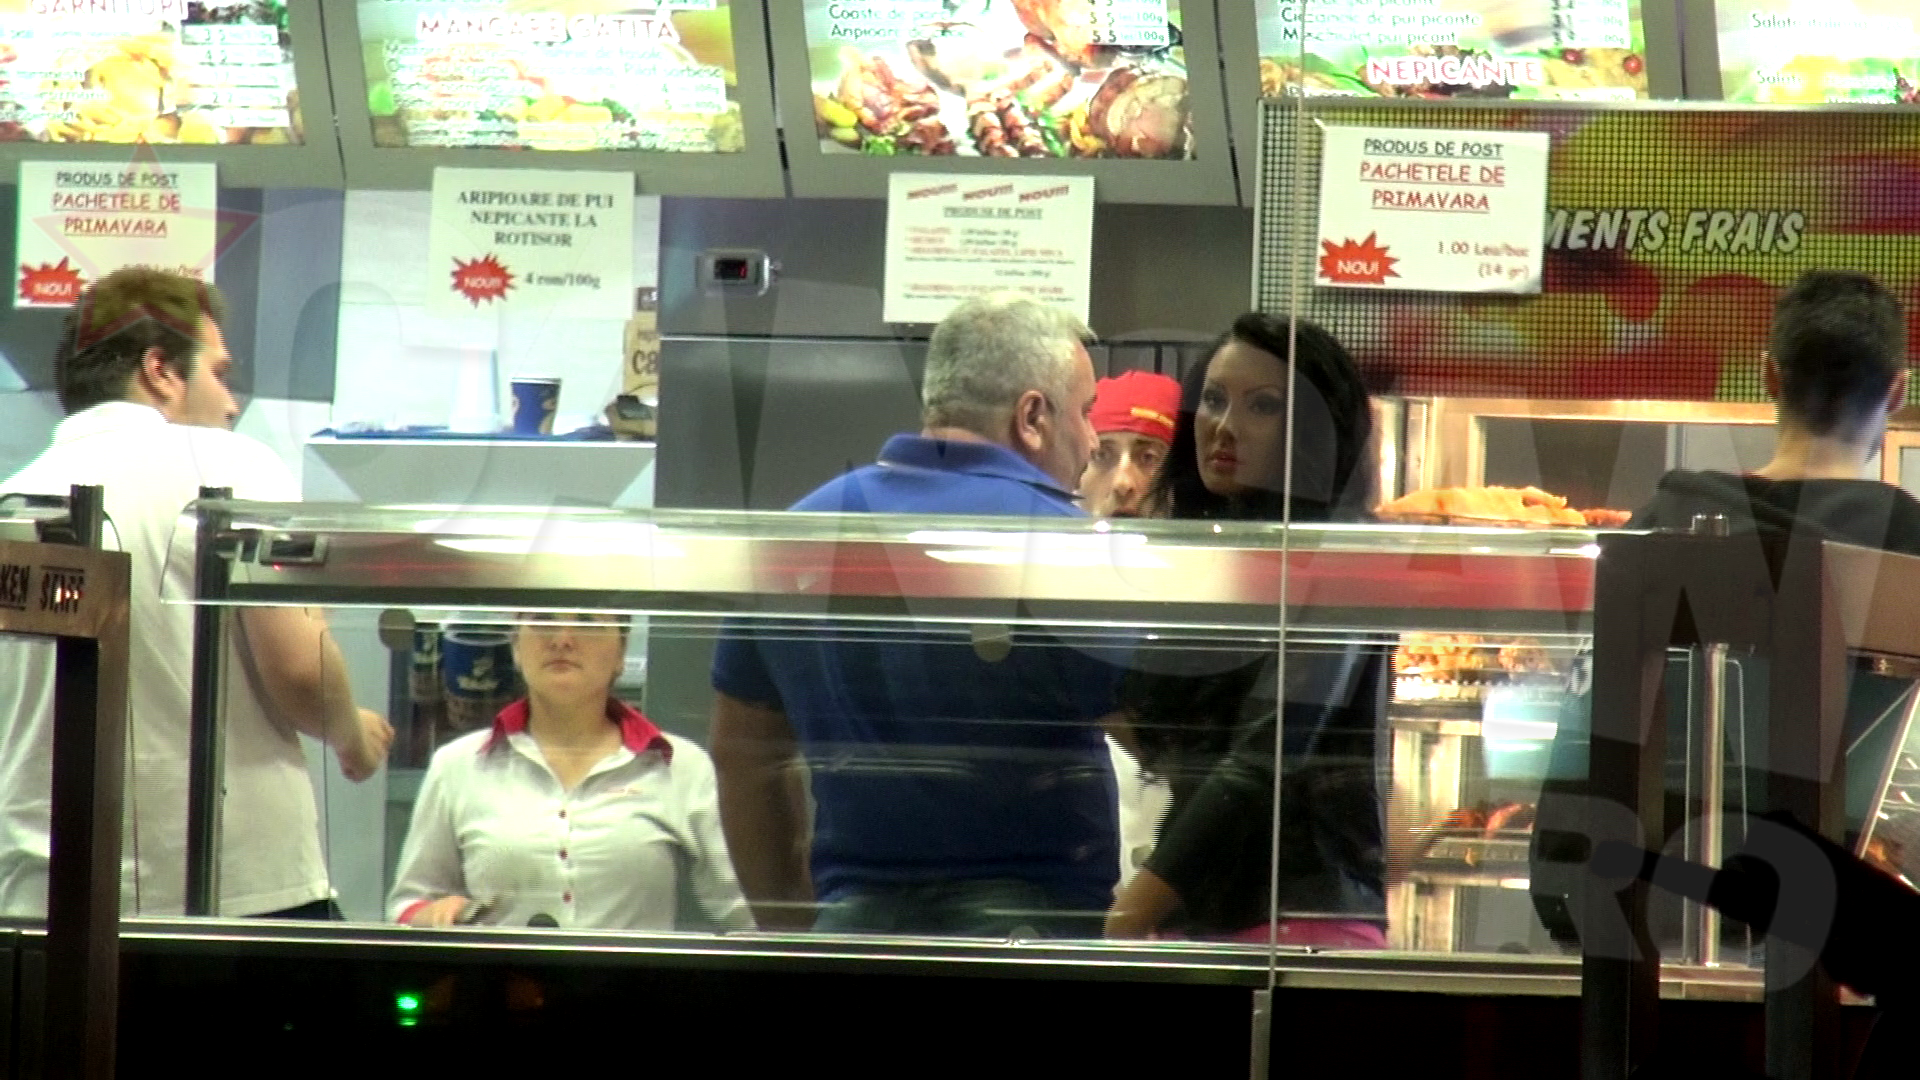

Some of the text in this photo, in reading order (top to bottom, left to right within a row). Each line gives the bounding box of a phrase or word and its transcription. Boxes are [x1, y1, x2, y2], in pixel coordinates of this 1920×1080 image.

[1372, 61, 1538, 82] NEPICANTE
[1364, 138, 1504, 157] PRODUS DE POST
[56, 171, 178, 187] PRODUS DE POST
[1360, 161, 1506, 184] PACHETELE DE
[53, 192, 181, 212] PACHETELE DE
[457, 190, 614, 208] ARIPIOARE DE PUI
[1372, 189, 1490, 210] PRIMAVARA
[64, 217, 168, 235] PRIMAVARA
[471, 210, 598, 227] NEPICANTE LA
[494, 231, 571, 247] ROTISOR
[1681, 210, 1804, 253] FRAIS
[1337, 261, 1380, 276] NOU!
